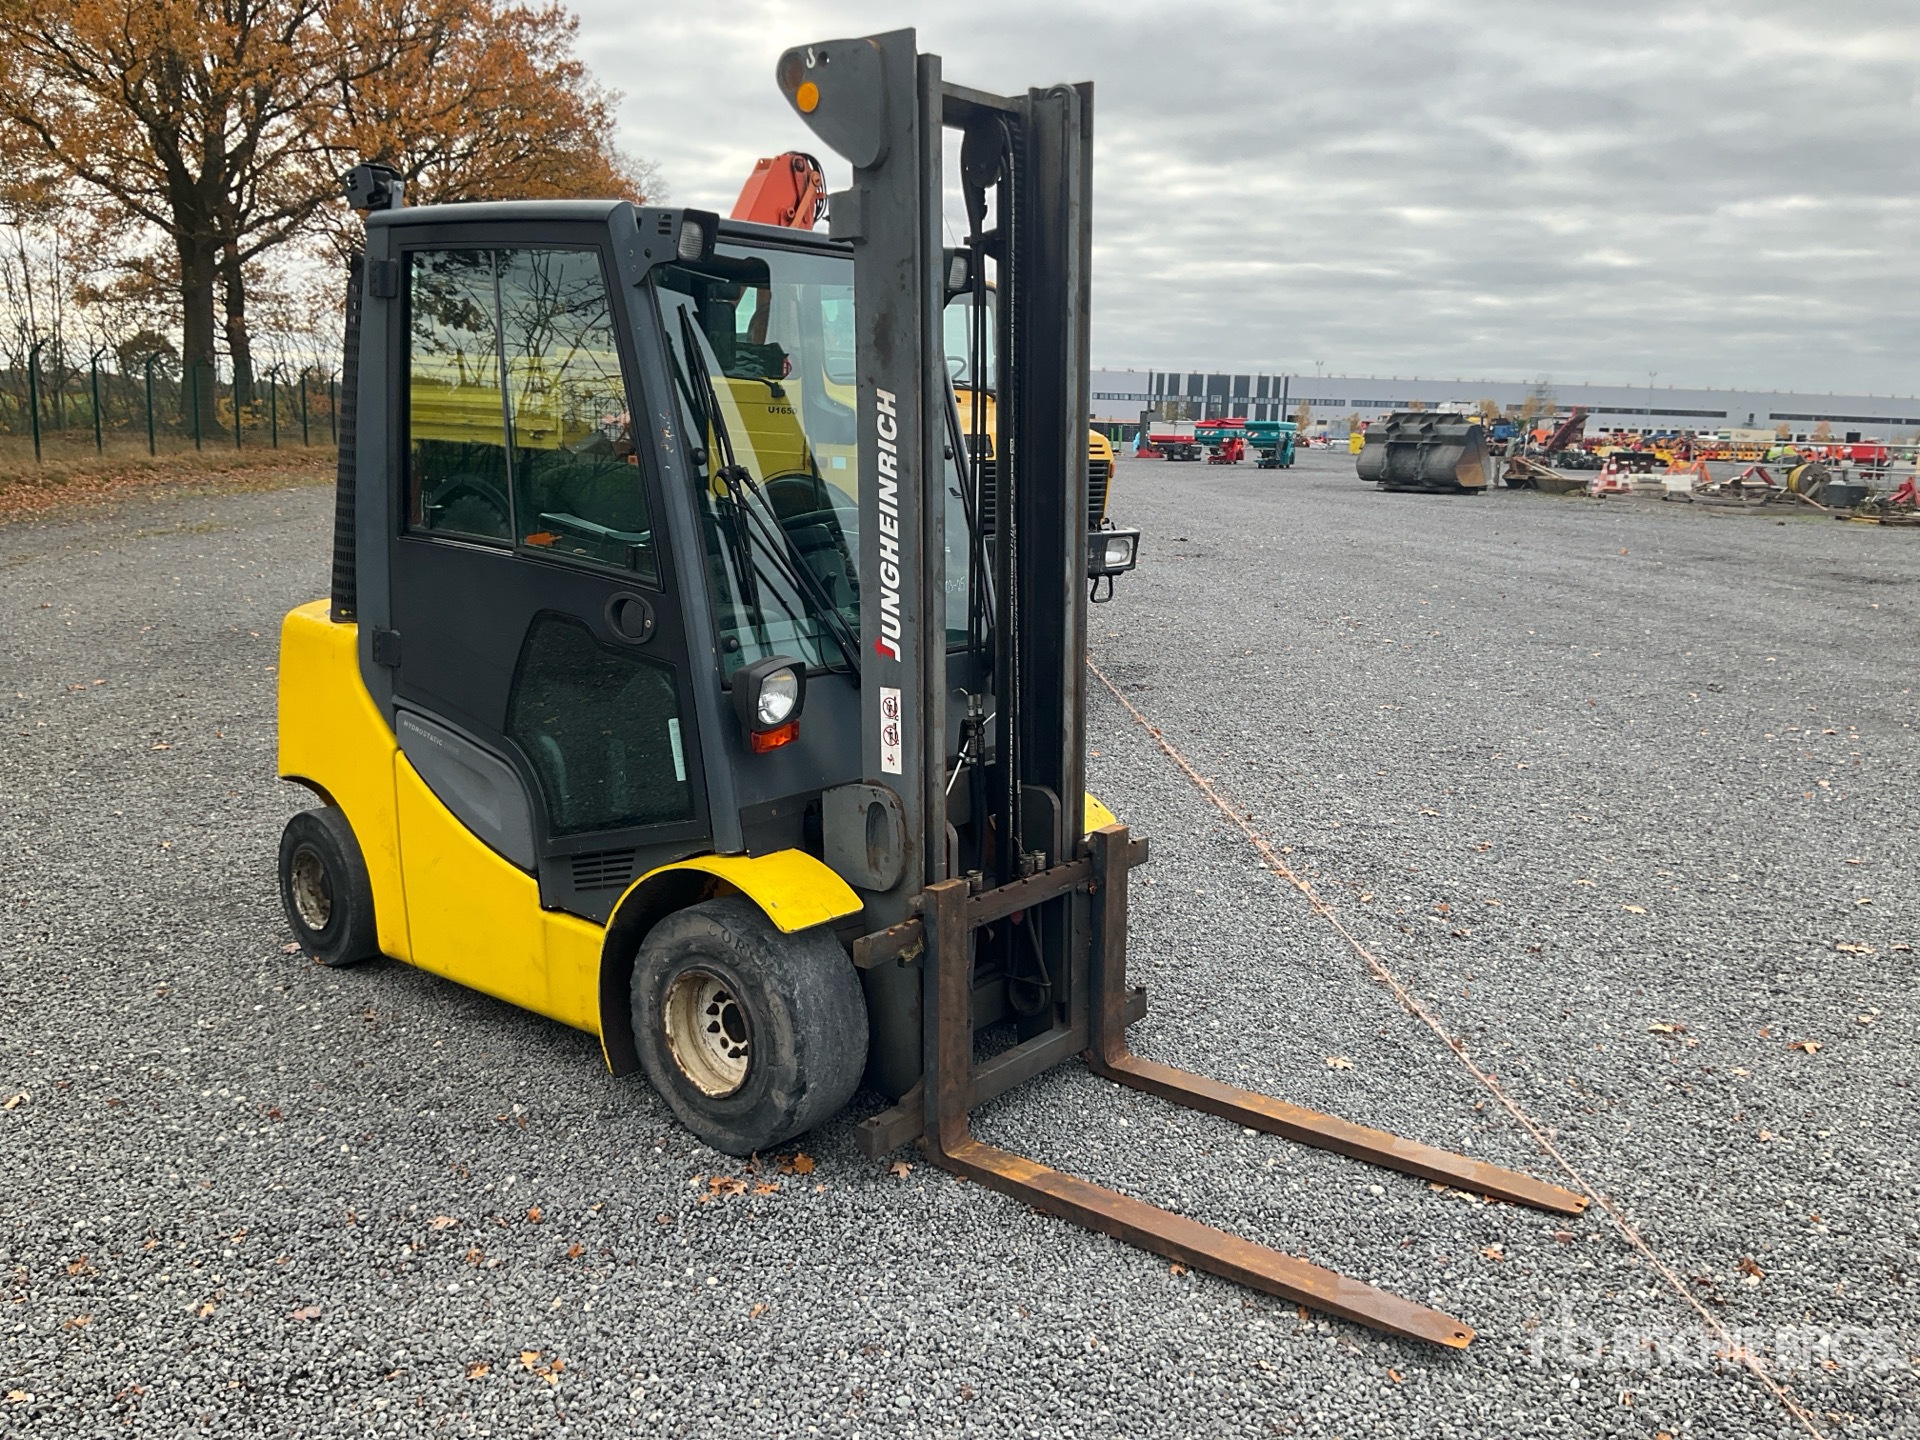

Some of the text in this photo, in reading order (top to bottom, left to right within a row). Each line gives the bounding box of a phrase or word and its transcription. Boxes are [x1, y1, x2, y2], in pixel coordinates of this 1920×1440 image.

[767, 406, 798, 415] U1650
[875, 388, 902, 663] JUNGHEINRICH
[403, 720, 443, 746] HYDROSTATIC
